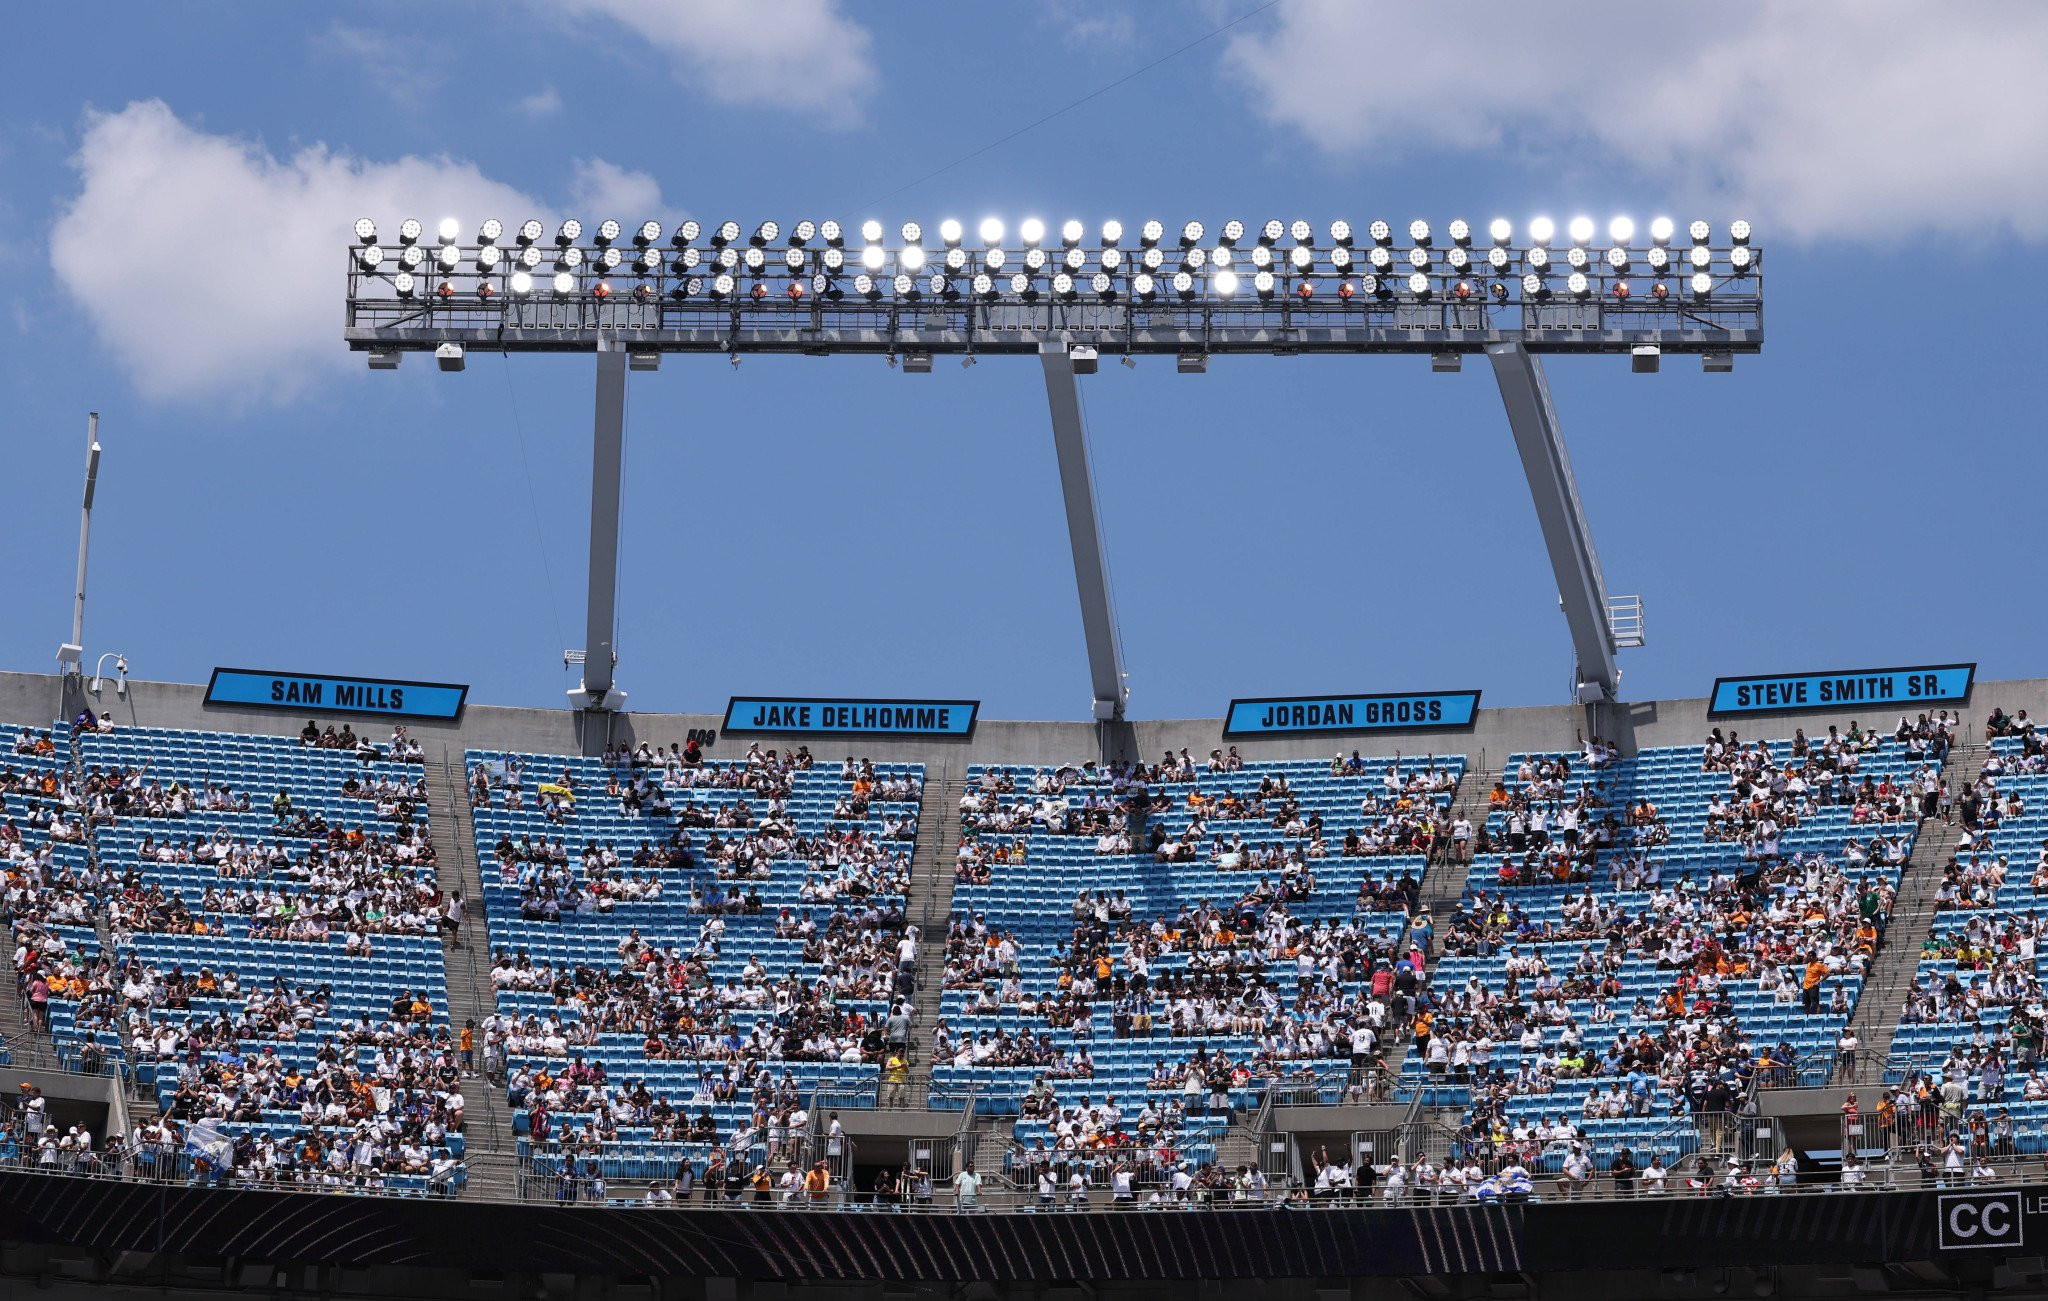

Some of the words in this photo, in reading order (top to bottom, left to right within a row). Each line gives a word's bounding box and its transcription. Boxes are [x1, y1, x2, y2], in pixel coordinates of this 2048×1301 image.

[271, 680, 322, 704] SAM
[336, 685, 404, 709] MILLS
[1737, 682, 1808, 706] STEVE
[1820, 677, 1893, 701] SMITH
[1908, 674, 1946, 696] SR.
[753, 705, 811, 727] JAKE
[822, 706, 950, 729] DELHOMME
[1261, 703, 1354, 727] JORDAN
[1366, 700, 1442, 724] GROSS
[2026, 1196, 2048, 1214] LE
[1950, 1201, 2011, 1238] CC
